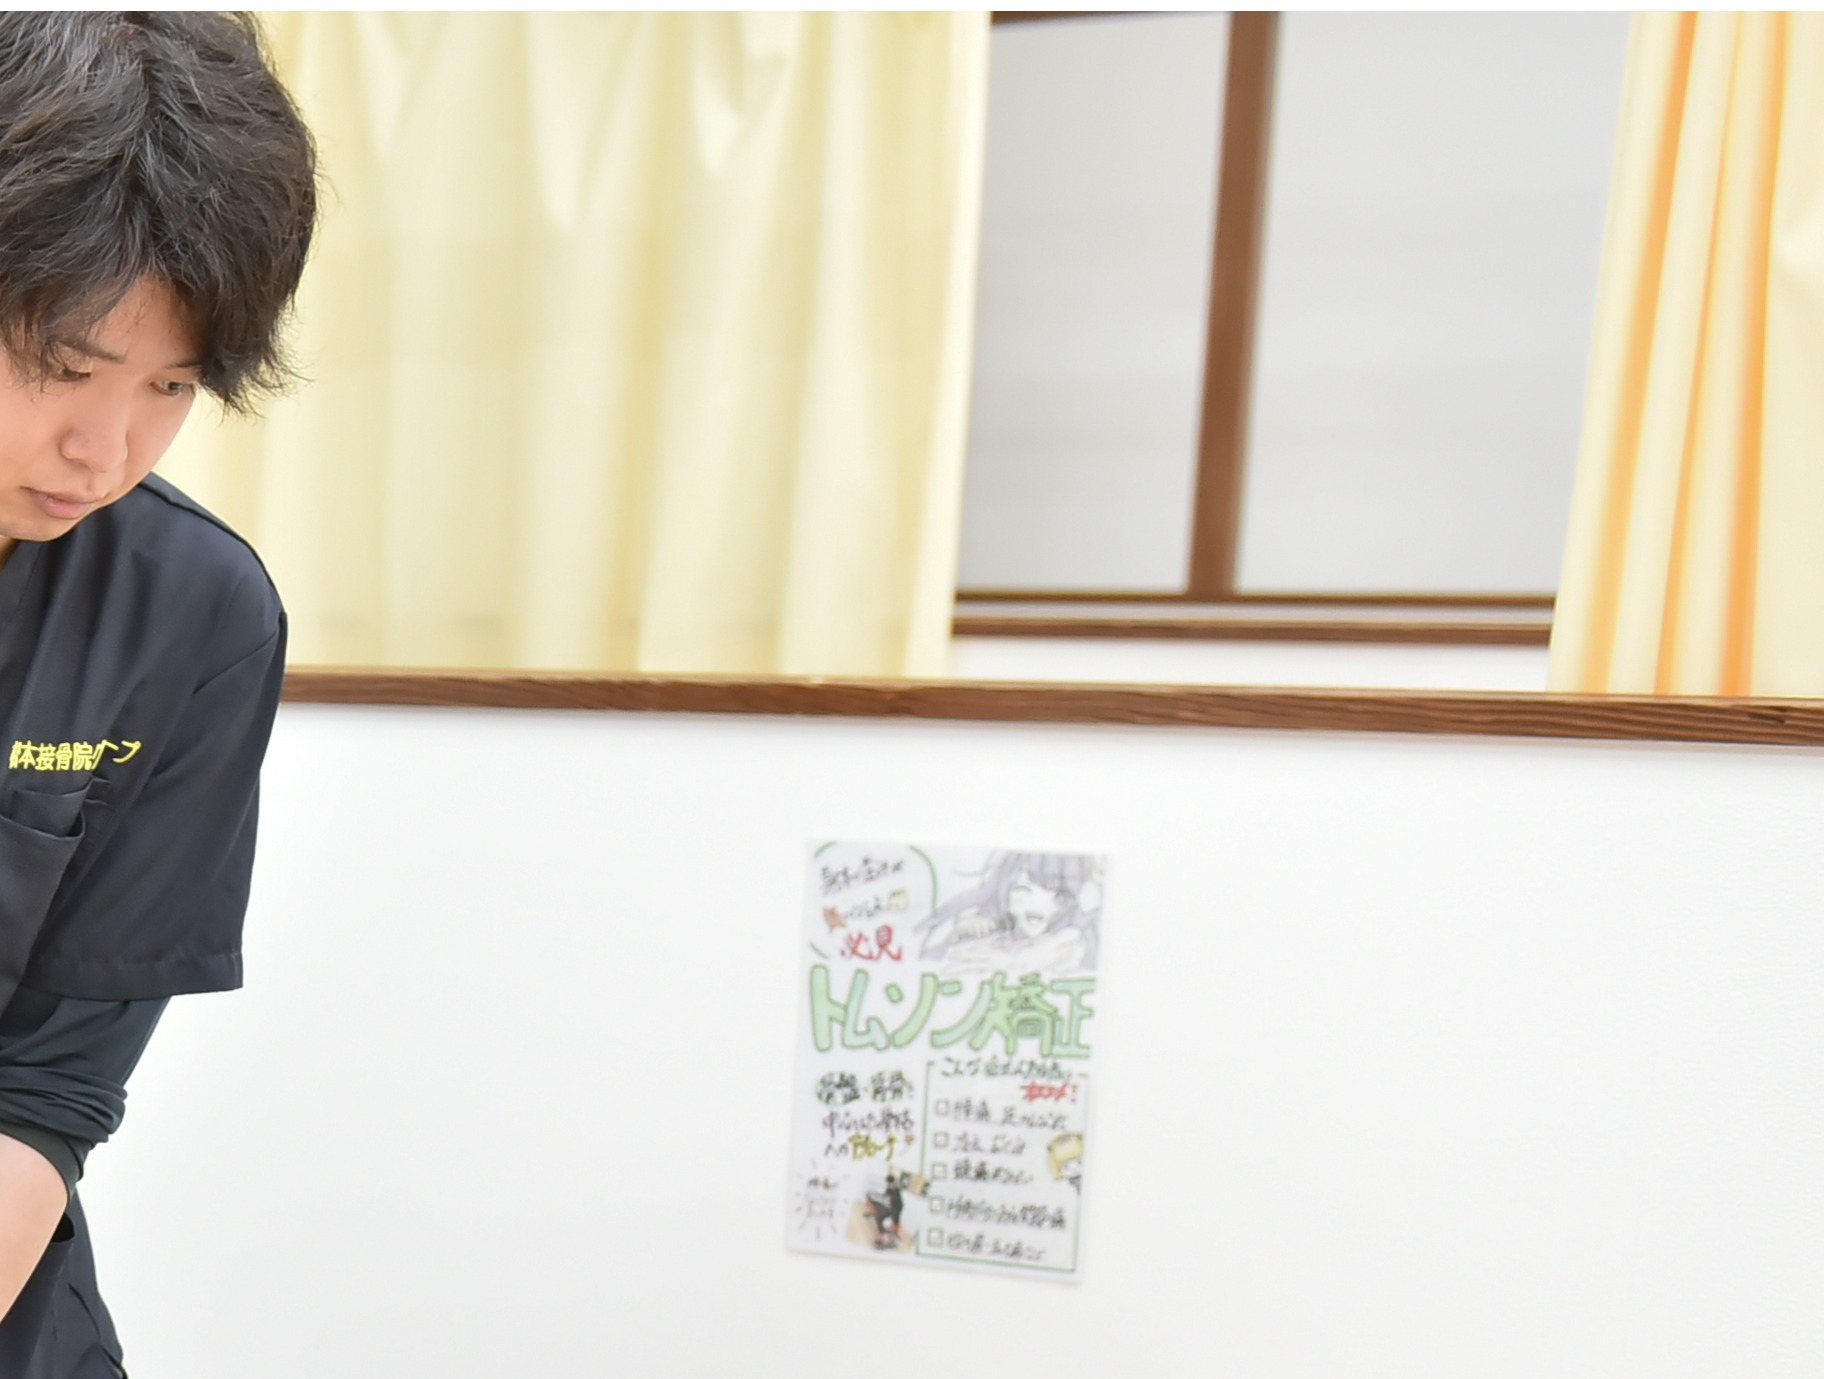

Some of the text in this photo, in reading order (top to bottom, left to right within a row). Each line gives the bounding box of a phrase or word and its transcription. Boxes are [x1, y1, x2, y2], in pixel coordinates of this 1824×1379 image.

[810, 964, 1096, 1058] トムソン矯正
